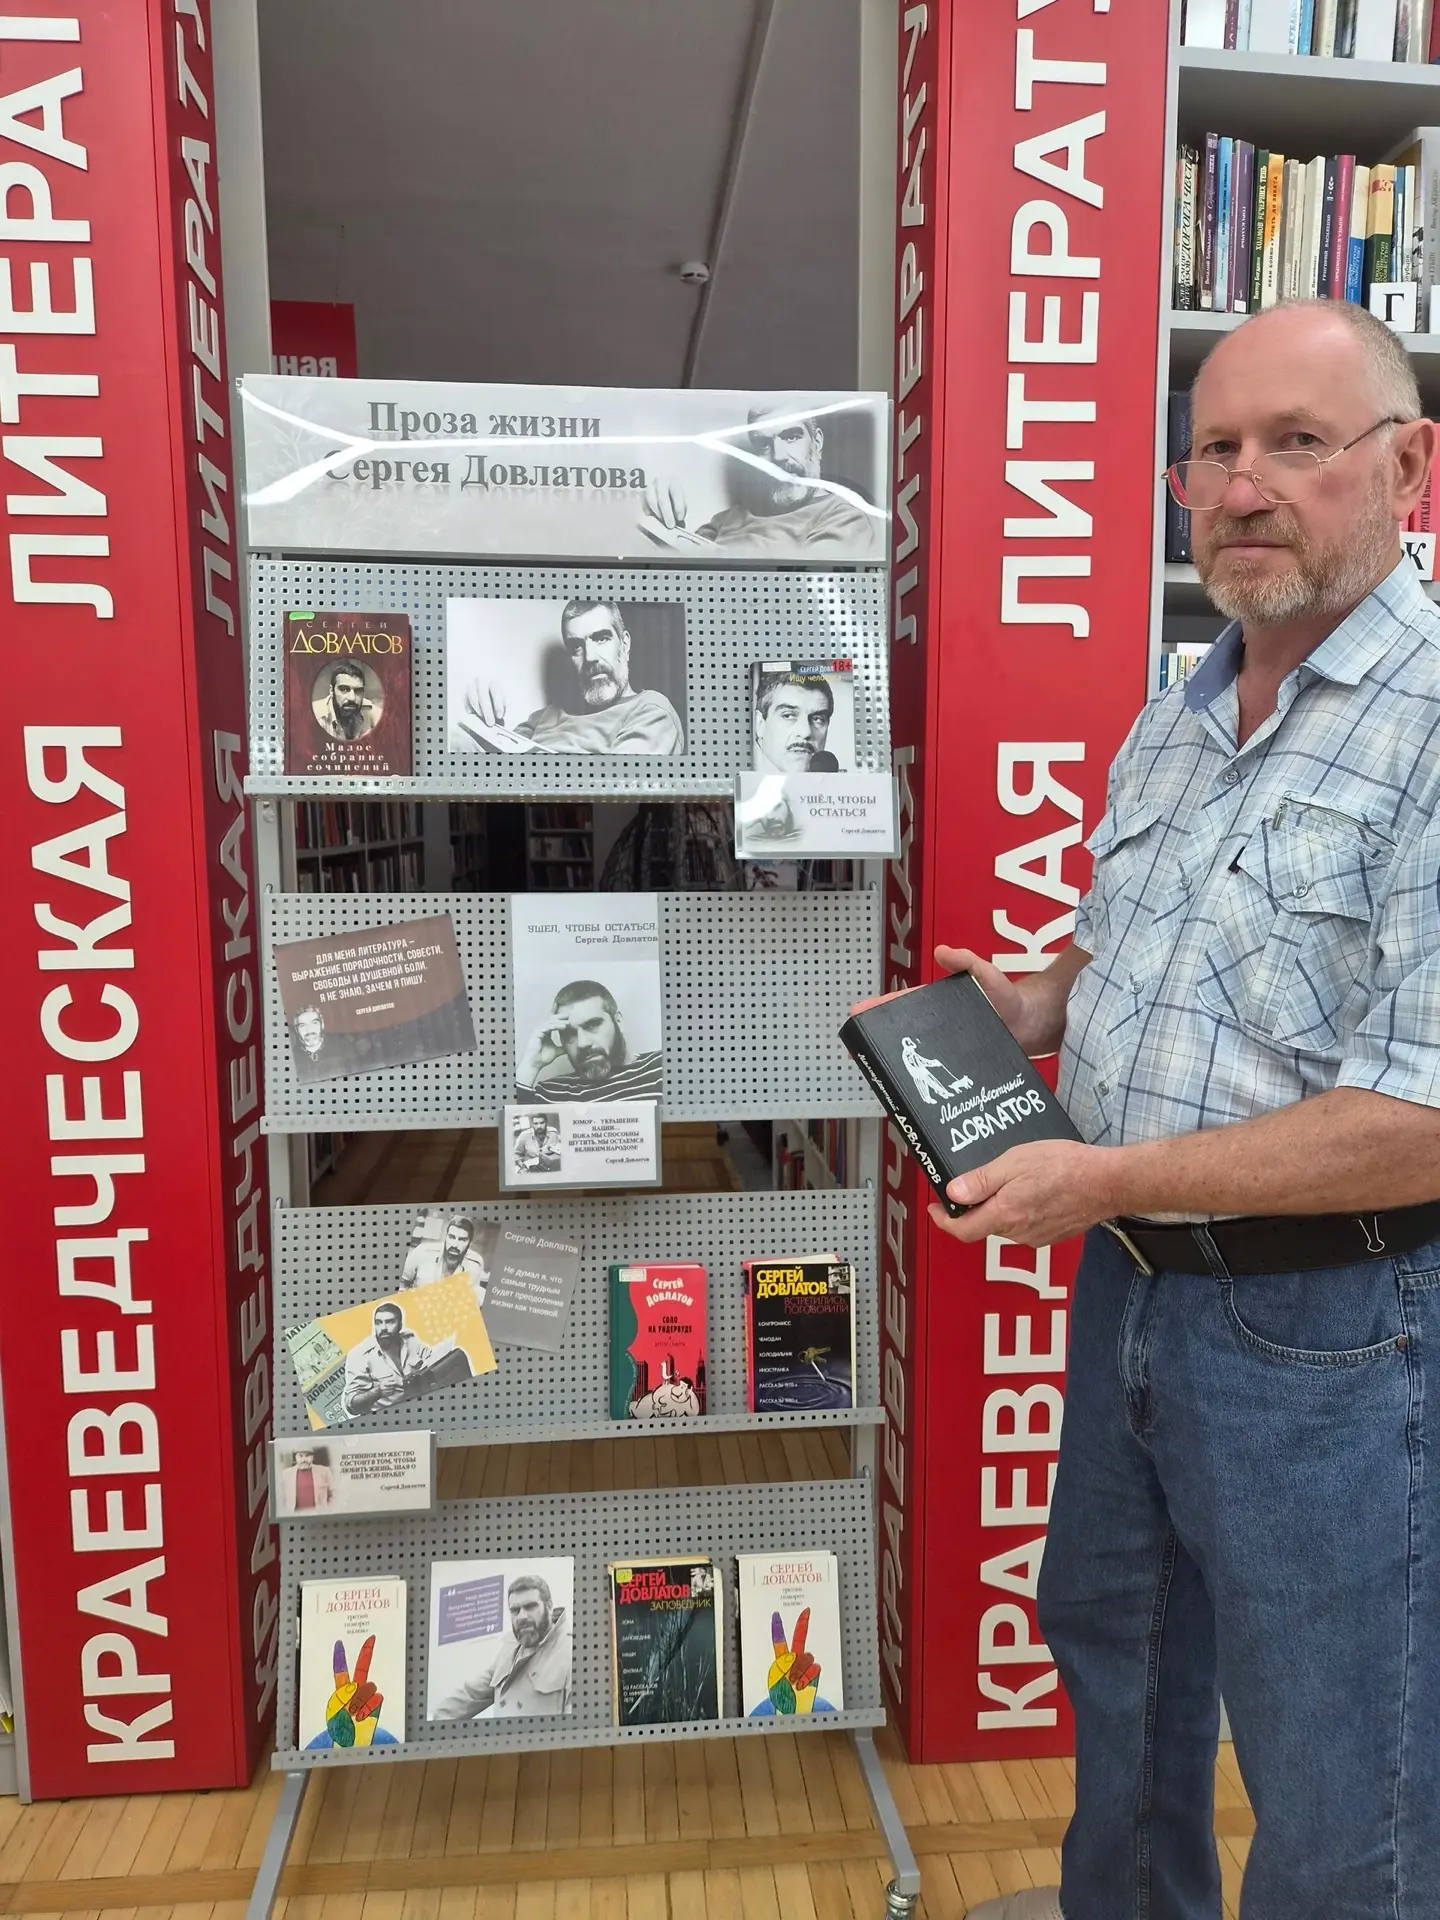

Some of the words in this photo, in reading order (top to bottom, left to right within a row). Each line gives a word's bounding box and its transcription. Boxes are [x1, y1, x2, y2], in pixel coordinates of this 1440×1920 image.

[1260, 165, 1268, 182] ТЕНЬ
[1258, 186, 1267, 220] ВЕЧЕРНИХ
[1272, 203, 1277, 213] ДО
[1181, 200, 1192, 255] ДОРОГА
[1256, 220, 1264, 251] ХОЛМОВ
[1383, 293, 1405, 322] Г
[367, 401, 479, 440] Проза
[488, 415, 601, 438] жизни
[324, 450, 451, 490] Сергея
[460, 455, 648, 491] Довлатова
[306, 621, 387, 629] СЕРГЕЙ
[290, 629, 403, 654] ДОВЛАТОВ
[832, 660, 853, 672] 18+
[790, 675, 806, 684] Ищу
[325, 742, 372, 751] Малое
[312, 752, 384, 763] собрание
[307, 762, 389, 771] сочинений
[800, 793, 835, 805] УШЁЛ,
[837, 796, 876, 804] ЧТОБЫ
[809, 808, 867, 817] ОСТАТЬСЯ
[528, 924, 560, 933] УШЕЛ,
[565, 923, 600, 932] ЧТОБЫ
[605, 922, 656, 931] ОСТАТЬСЯ
[575, 936, 608, 945] Сергей
[613, 935, 658, 943] Довлатов
[316, 954, 333, 965] ДЛЯ
[335, 949, 356, 960] МЕНЯ
[358, 939, 408, 956] ЛИТЕРАТУРА
[292, 964, 342, 981] ВЫРАЖЕНИЕ
[313, 976, 351, 991] СВОБОДЫ
[352, 975, 359, 983] И
[360, 965, 403, 983] ДУШЕВНОЙ
[320, 994, 325, 1003] Я
[327, 992, 338, 1001] НЕ
[366, 981, 393, 994] ЗАЧЕМ
[394, 979, 400, 988] Я
[401, 974, 426, 987] ПИШУ.
[940, 1073, 1026, 1124] Малоизвестный
[950, 1089, 1046, 1153] ДОВЛАТОВ
[895, 1113, 942, 1184] ДОВЛАТОВ
[504, 1232, 536, 1245] Сергей
[536, 1238, 578, 1254] Довлатов
[977, 742, 1086, 1729] КРАЕВЕДКАЯ
[23, 726, 175, 1763] КРАЕВЕДЧЕСКАЯ
[504, 1265, 515, 1274] Не
[515, 1270, 540, 1279] думал
[550, 1276, 563, 1284] что
[653, 1277, 684, 1289] СЕРГЕЙ
[756, 1266, 803, 1283] СЕРГЕЙ
[501, 1278, 526, 1288] самым
[528, 1283, 561, 1295] трудным
[757, 1282, 828, 1299] ДОВЛАТОВ
[491, 1286, 514, 1297] будет
[515, 1292, 564, 1307] преодоление
[646, 1291, 694, 1308] ДОВЛАТОВ
[491, 1300, 514, 1309] жизни
[515, 1303, 527, 1312] как
[784, 1305, 848, 1314] ПОГОВОРИЛИ
[662, 1316, 678, 1324] СОЛО
[658, 1326, 692, 1334] УНДЕРВУДЕ
[307, 1364, 346, 1404] ДОВЛАТО
[770, 1561, 813, 1574] СЕРГЕЙ
[762, 1573, 823, 1586] ДОВЛАТОВ
[335, 1587, 381, 1601] СЕРГЕЙ
[620, 1584, 691, 1605] ДОВЛАТОВ
[325, 1599, 390, 1613] ДОВЛАТОВ
[650, 1599, 712, 1611] ЗАПОВЕДНИК
